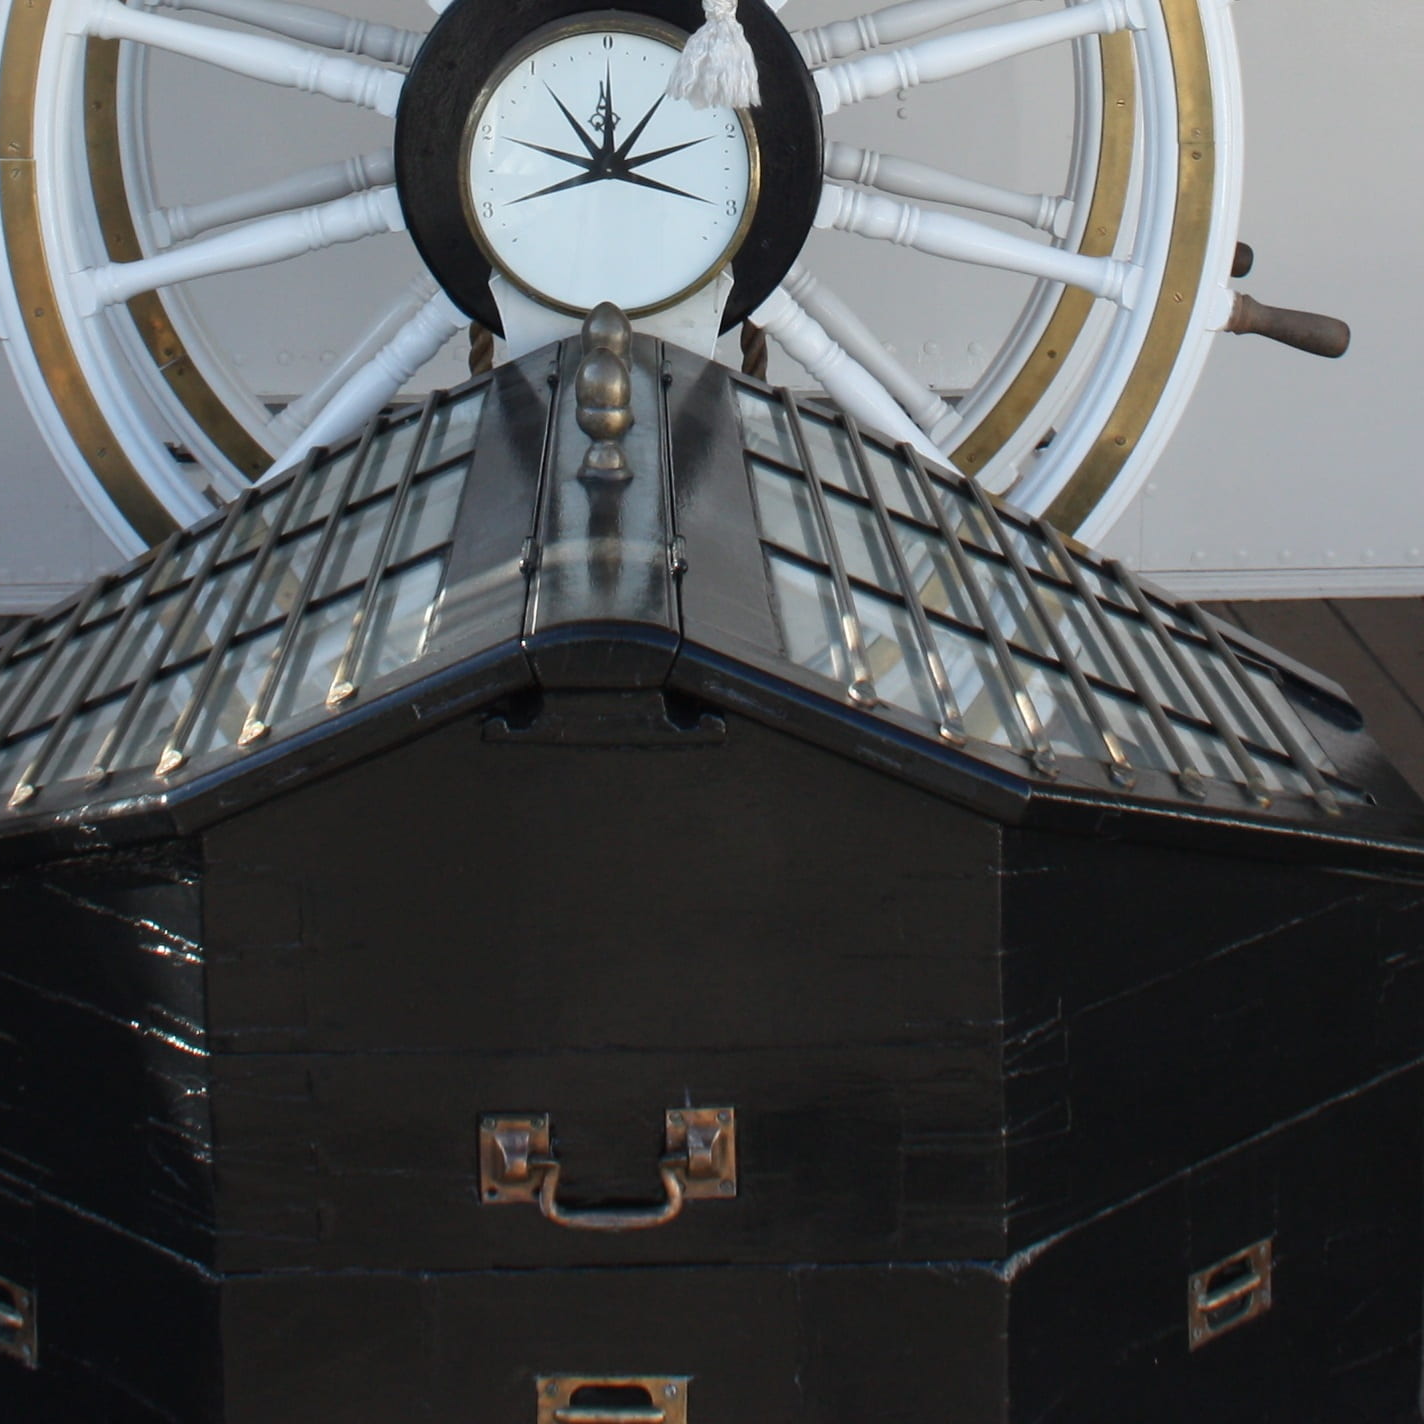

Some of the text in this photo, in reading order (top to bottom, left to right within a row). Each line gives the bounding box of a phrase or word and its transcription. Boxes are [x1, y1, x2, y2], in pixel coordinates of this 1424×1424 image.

[602, 35, 614, 50] 0
[481, 125, 493, 141] 2
[724, 123, 737, 139] 2
[482, 202, 494, 219] 3
[726, 200, 738, 217] 3
